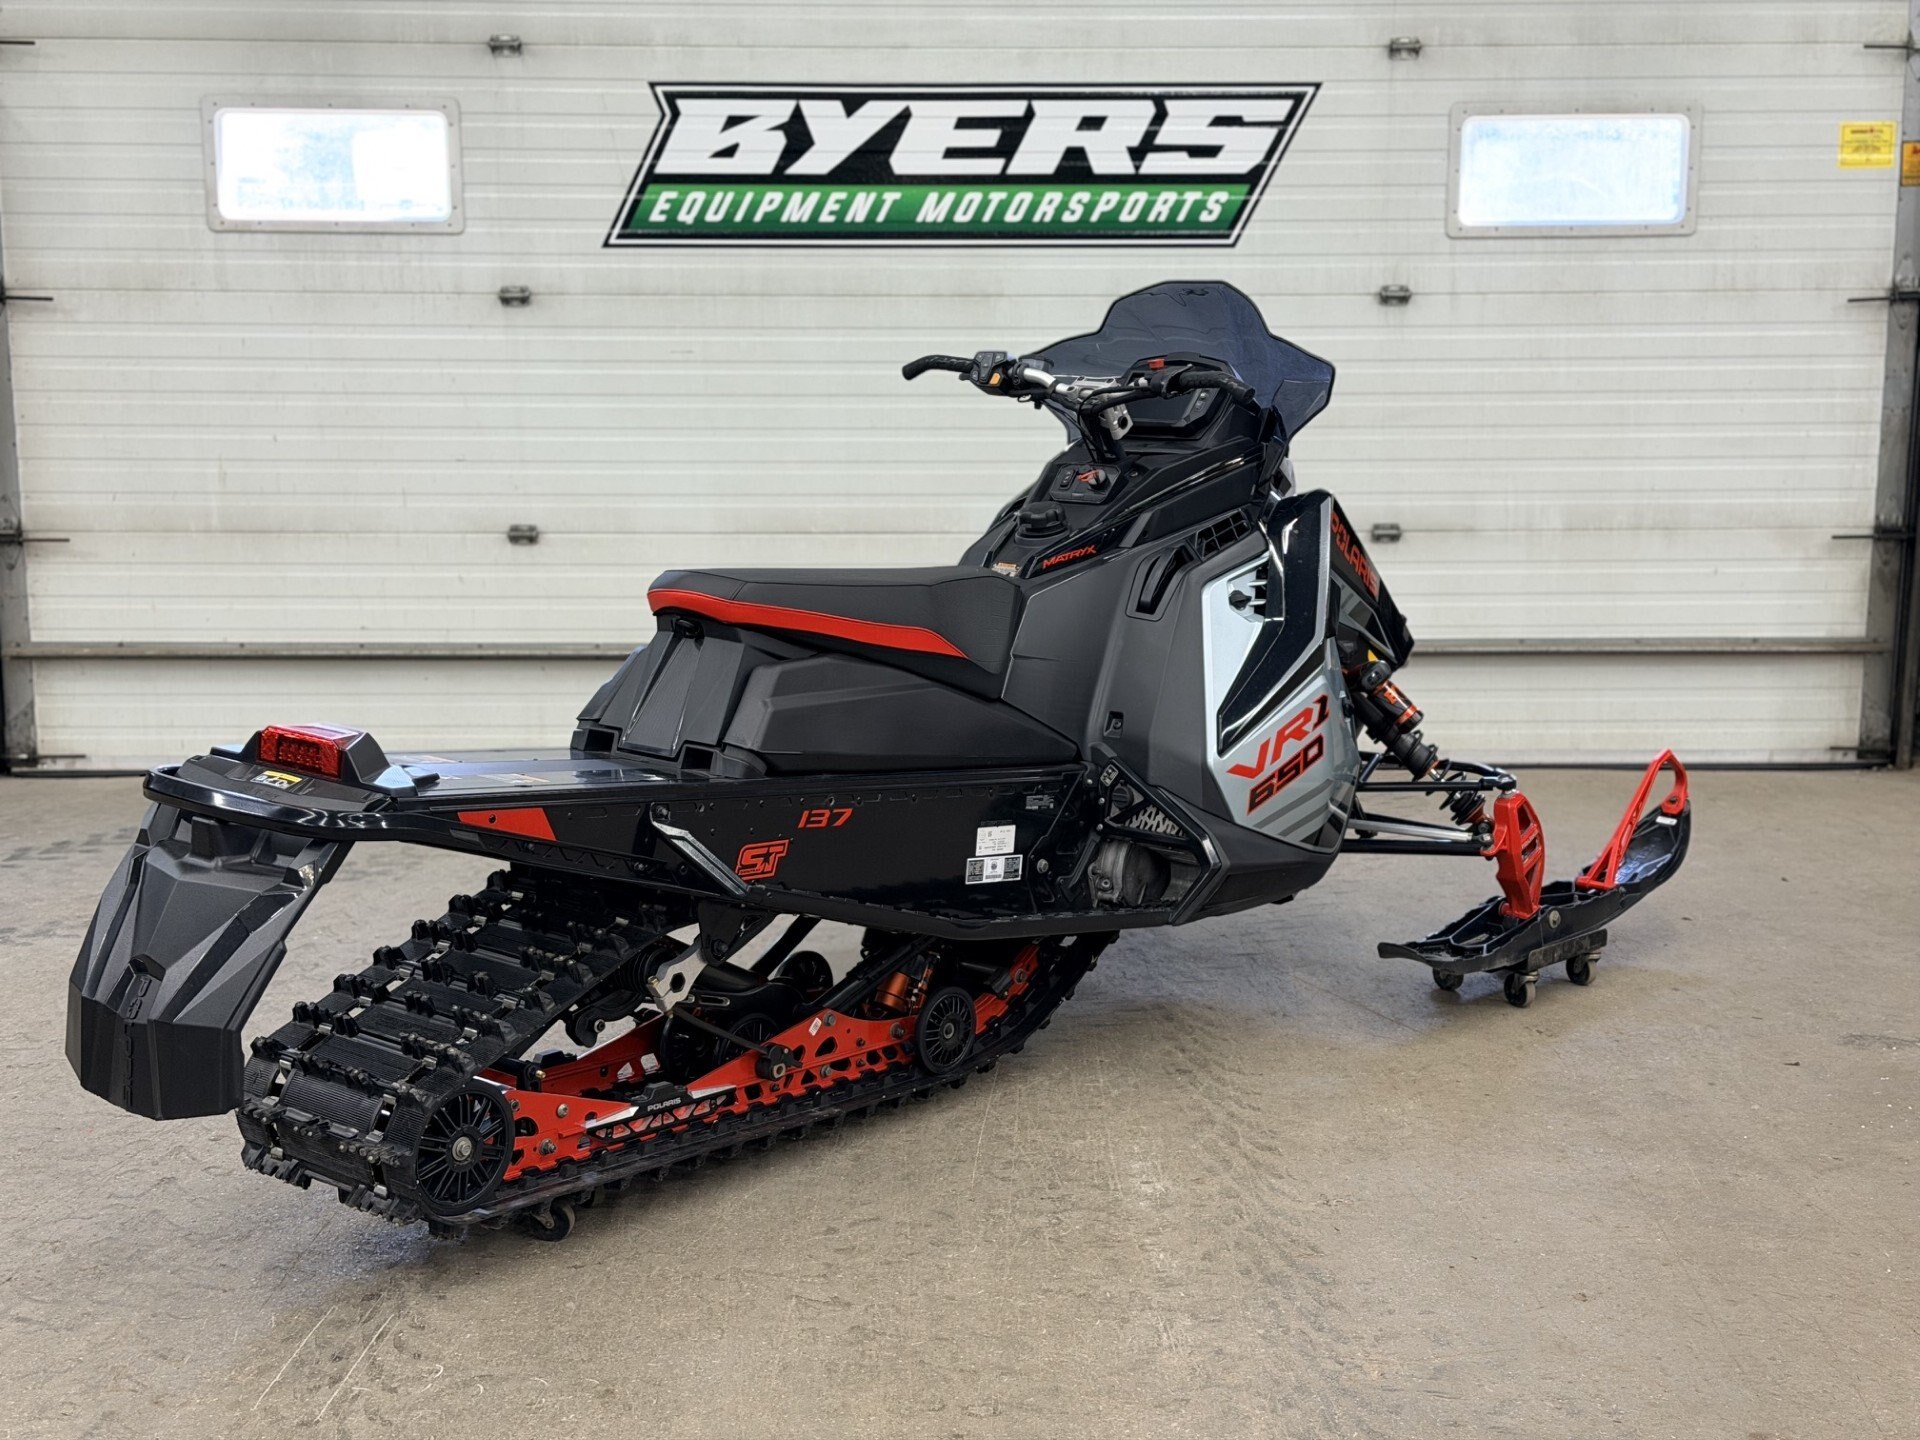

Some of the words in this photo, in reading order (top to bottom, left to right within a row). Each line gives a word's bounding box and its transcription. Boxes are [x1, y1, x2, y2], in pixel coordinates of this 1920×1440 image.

[653, 98, 1295, 175] BYERS
[648, 190, 902, 224] EQUIPMENT
[915, 190, 1230, 223] MOTORSPORTS
[1042, 544, 1097, 569] MATRYX
[1330, 511, 1378, 600] POLARIS
[1226, 694, 1329, 779] VR1
[1247, 732, 1324, 816] 650
[797, 807, 853, 829] 137
[647, 1097, 682, 1111] POLARIS
